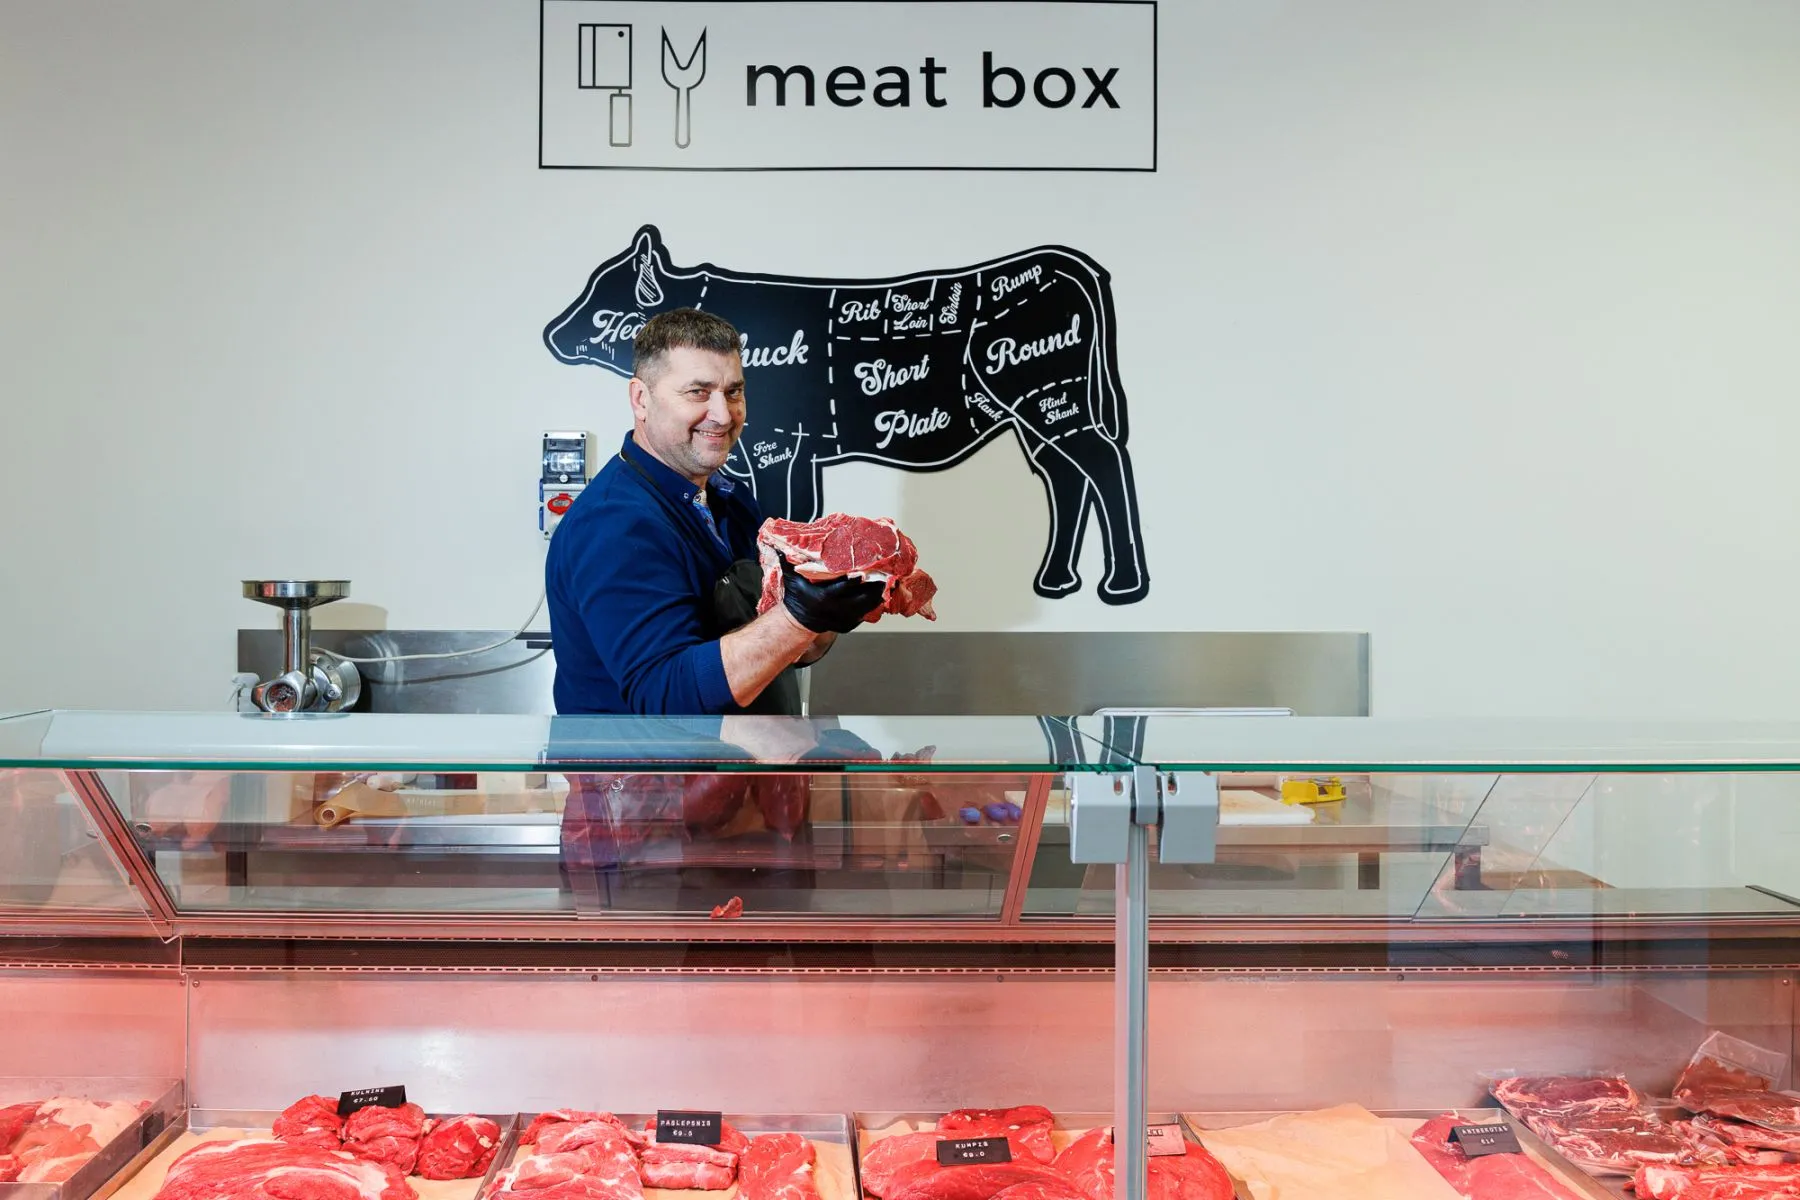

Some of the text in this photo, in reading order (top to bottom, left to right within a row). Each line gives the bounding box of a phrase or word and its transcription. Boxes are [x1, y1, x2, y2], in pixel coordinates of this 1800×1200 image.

[746, 50, 1121, 109] meat box
[990, 263, 1042, 301] Rump
[838, 299, 881, 324] Rib
[891, 294, 930, 313] Short
[938, 281, 963, 325] Sirloin
[893, 311, 928, 331] Loin
[740, 329, 809, 368] huck
[985, 313, 1081, 375] Round
[854, 354, 930, 396] Short
[968, 392, 1002, 422] Flank
[1038, 391, 1068, 412] Hind
[1044, 403, 1080, 425] Shank
[874, 407, 951, 449] Plate
[752, 441, 778, 457] Fore
[757, 447, 793, 470] Shank
